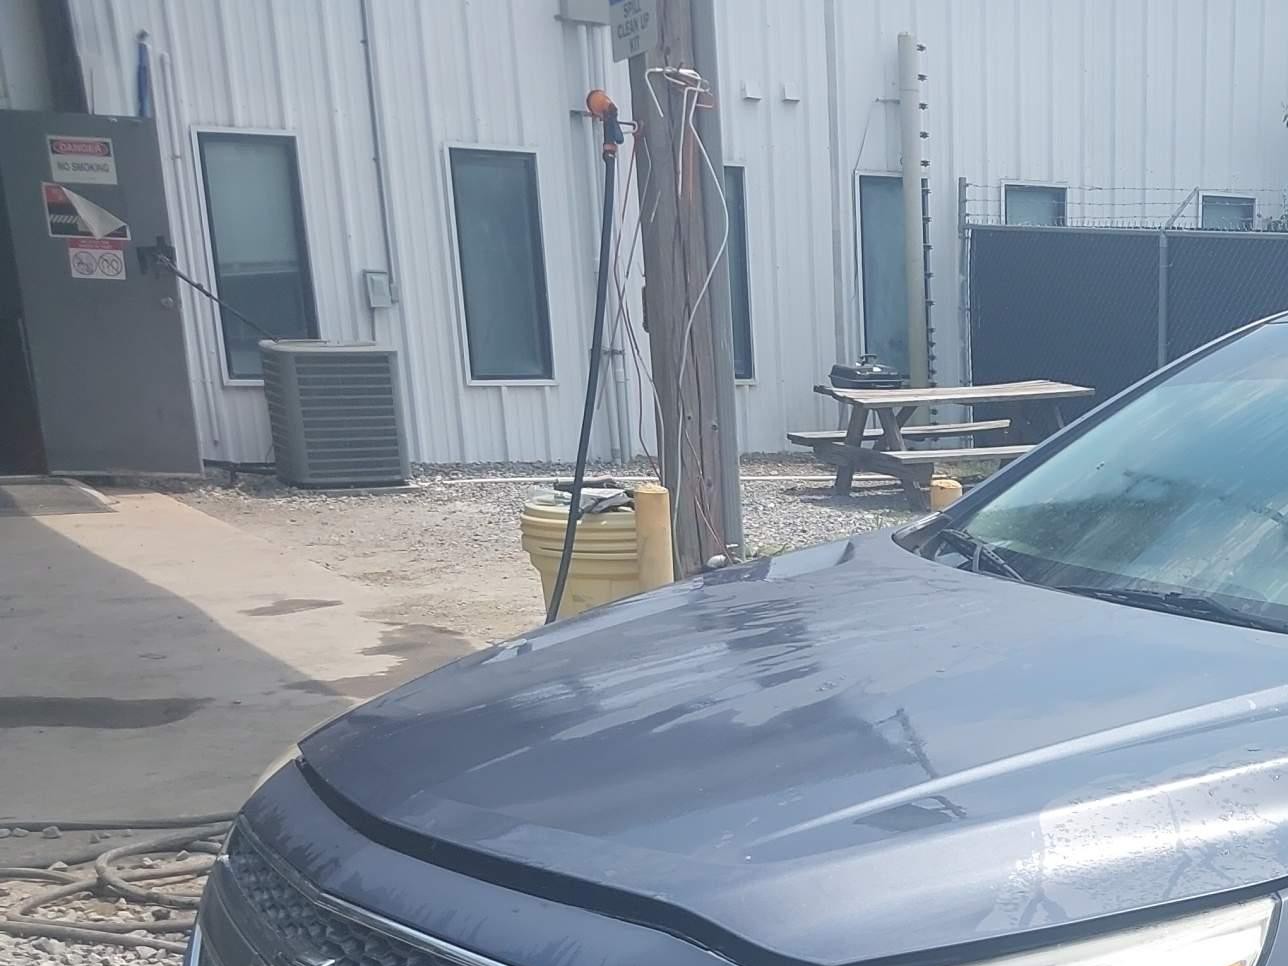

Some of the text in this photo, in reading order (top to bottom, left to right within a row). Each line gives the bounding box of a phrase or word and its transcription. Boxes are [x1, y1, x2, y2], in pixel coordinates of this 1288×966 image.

[616, 12, 649, 39] CLEAN UP
[59, 142, 103, 153] DANGER
[57, 161, 109, 173] NO SMOKING
